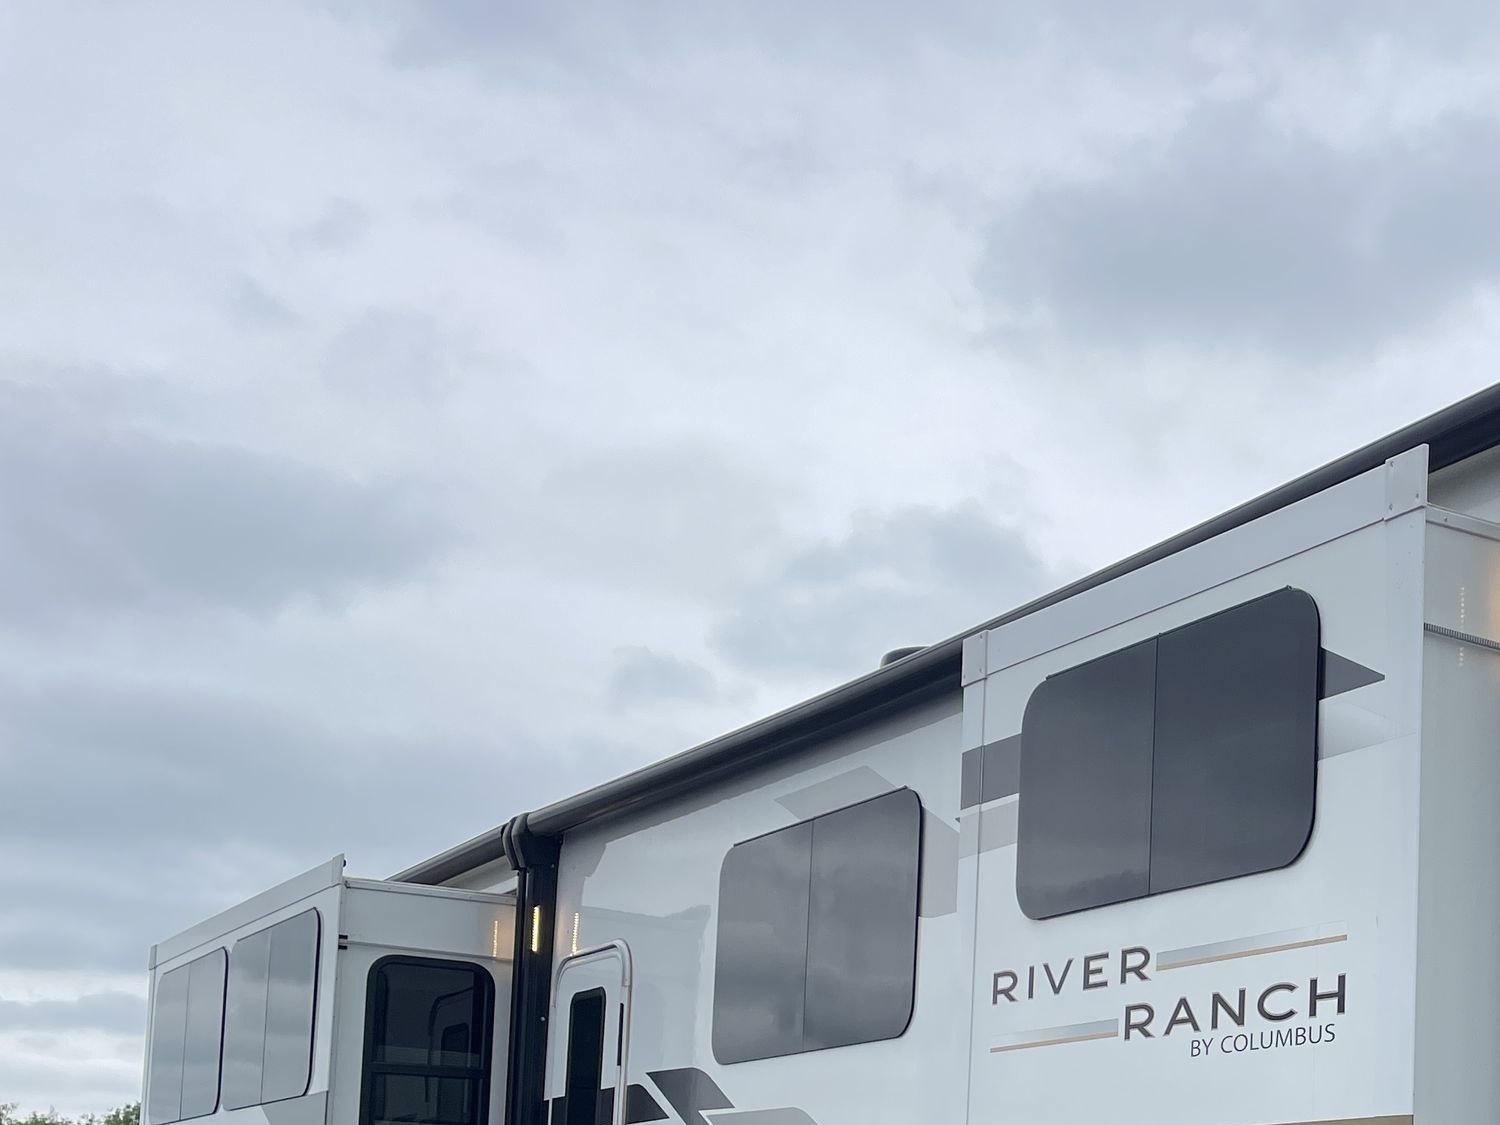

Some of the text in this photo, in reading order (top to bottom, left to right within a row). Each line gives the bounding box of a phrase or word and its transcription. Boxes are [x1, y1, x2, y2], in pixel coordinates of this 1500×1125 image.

[991, 945, 1152, 1005] RIVER
[1123, 972, 1347, 1041] RANCH
[1190, 1023, 1336, 1058] BY COLUMBUS
